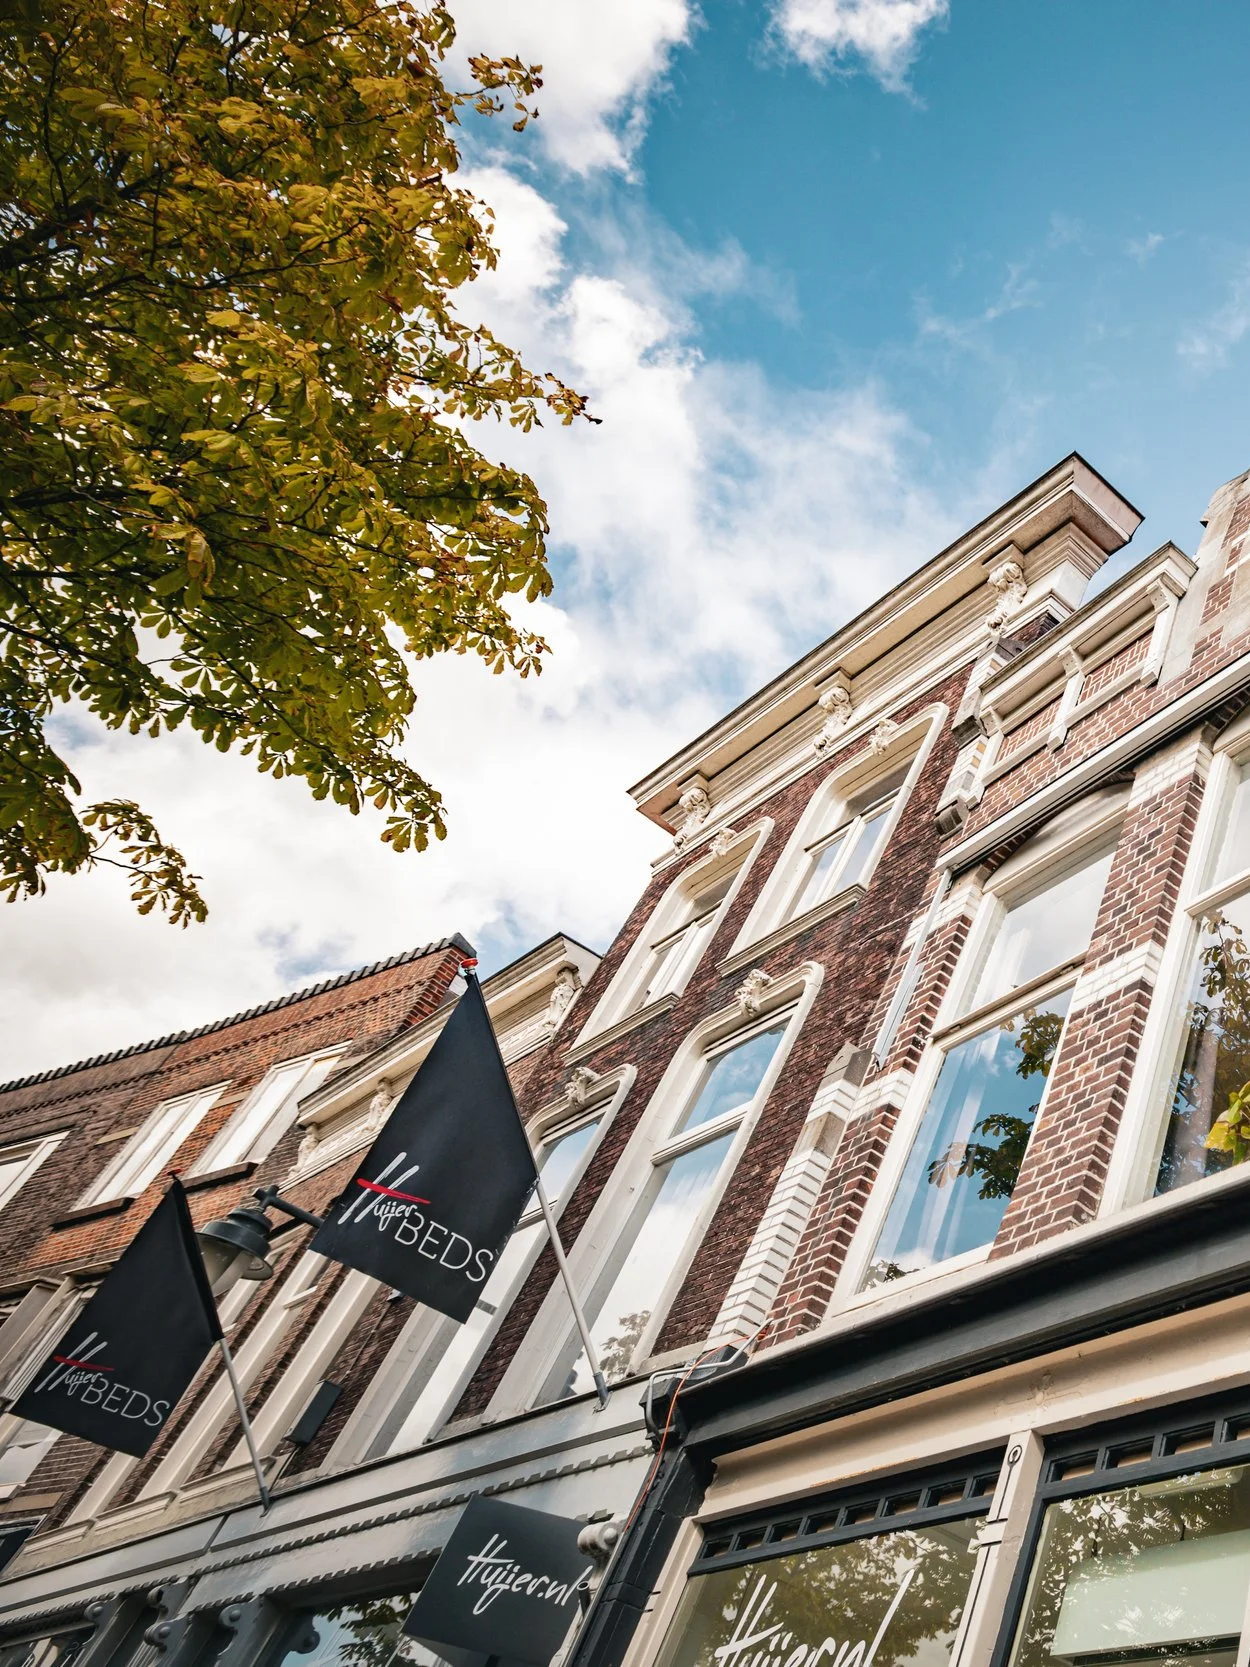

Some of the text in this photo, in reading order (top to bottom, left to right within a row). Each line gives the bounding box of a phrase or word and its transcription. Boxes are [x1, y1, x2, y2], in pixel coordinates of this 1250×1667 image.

[337, 1151, 431, 1231] Huijer
[394, 1212, 494, 1282] BEDS
[34, 1331, 115, 1396] Huijer
[81, 1377, 170, 1426] BEDS
[456, 1533, 594, 1615] Huijer.nl
